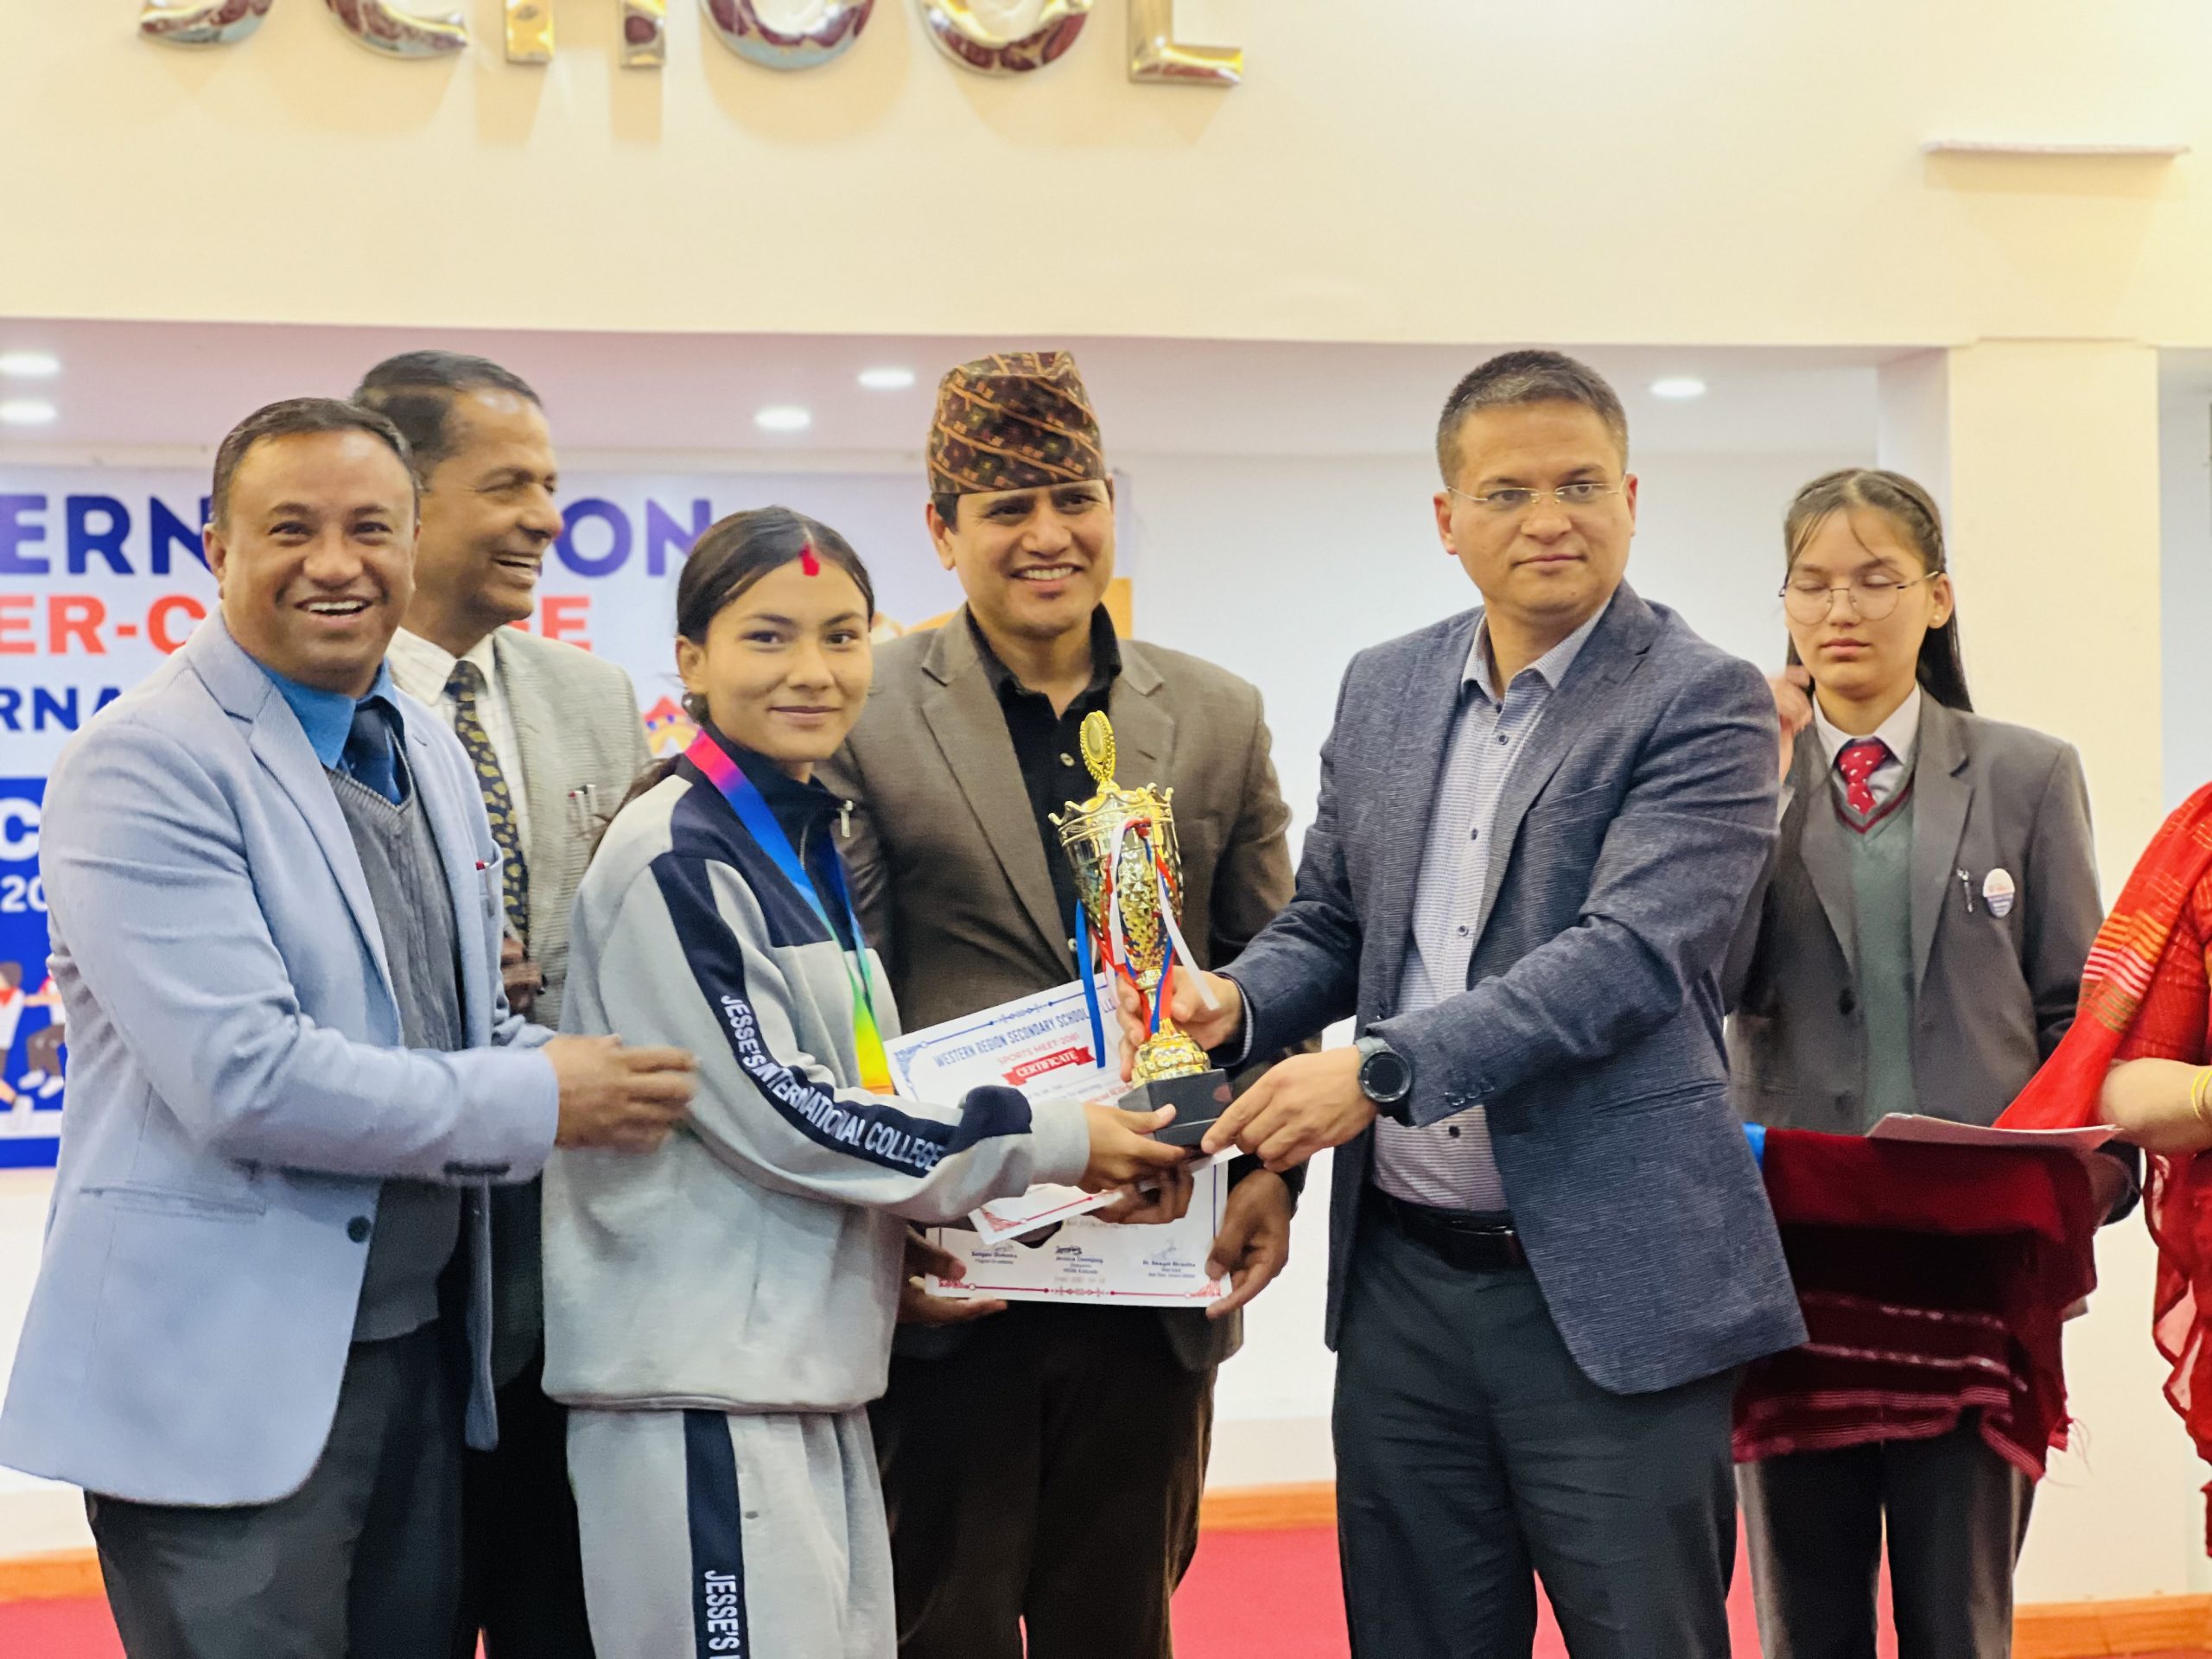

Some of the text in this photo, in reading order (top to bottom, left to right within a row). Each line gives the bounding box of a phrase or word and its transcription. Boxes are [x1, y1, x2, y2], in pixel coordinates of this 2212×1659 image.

[535, 498, 711, 578] ON
[933, 1008, 1090, 1066] WESTERN REGION SECONDARY SCHOOL
[1016, 1050, 1077, 1077] CERTIFICATE
[721, 995, 766, 1068] JESSE'S
[865, 1122, 946, 1172] COLLEGE
[704, 1570, 741, 1650] JESSE'S
